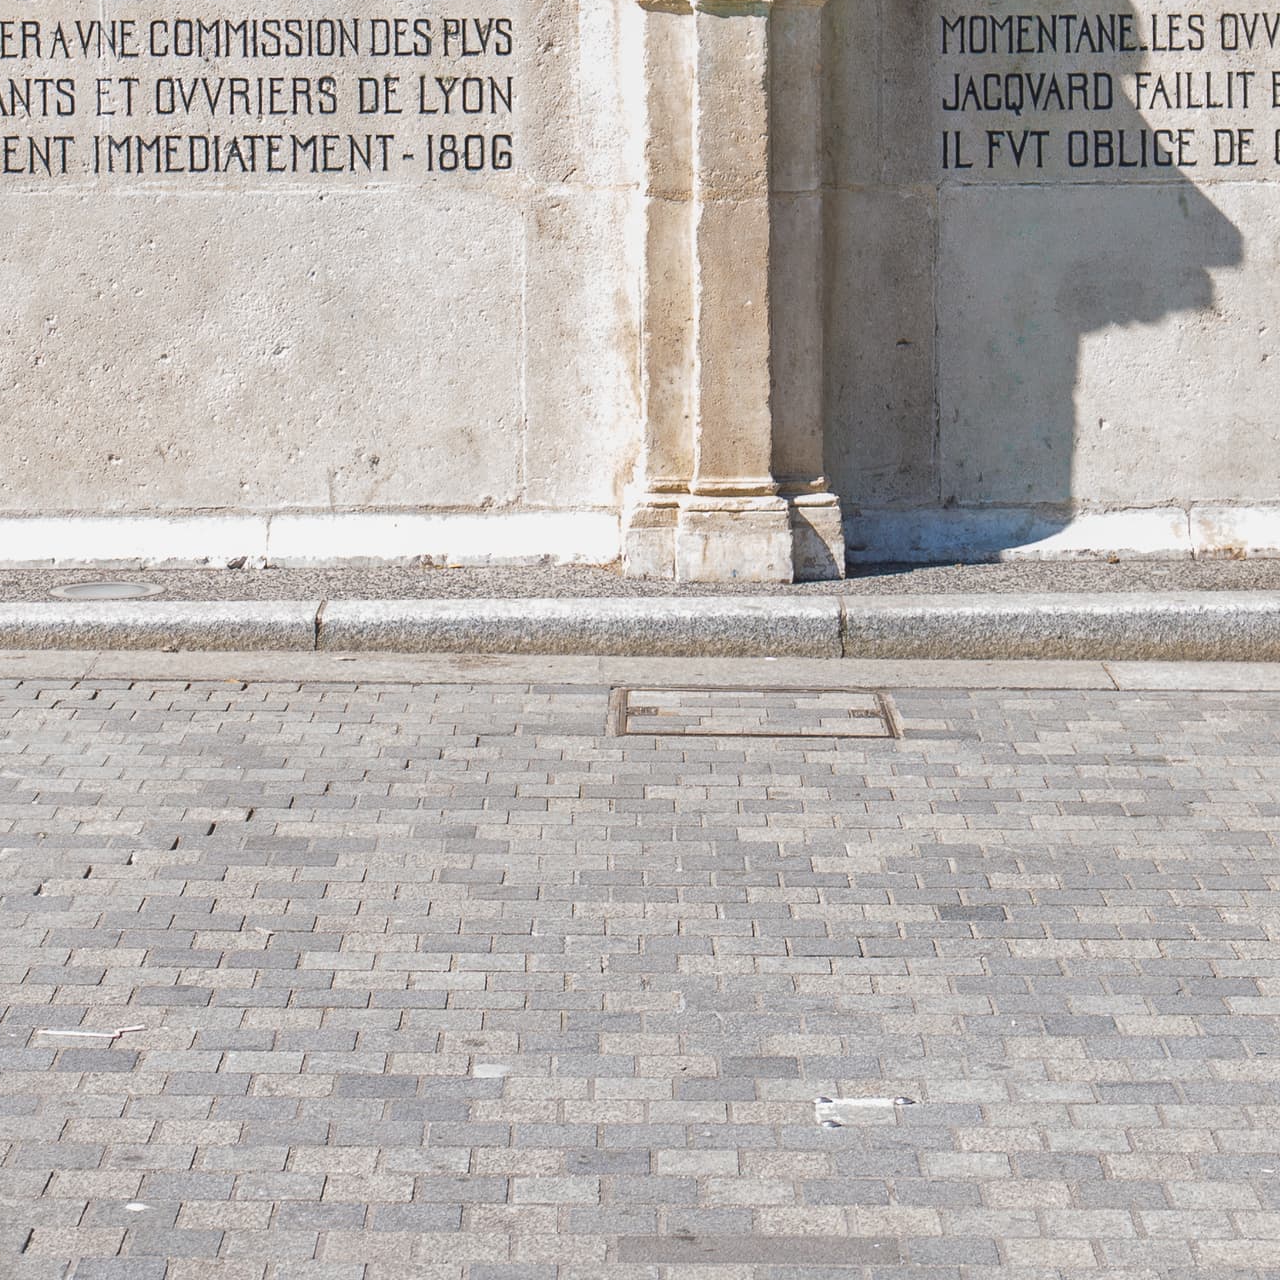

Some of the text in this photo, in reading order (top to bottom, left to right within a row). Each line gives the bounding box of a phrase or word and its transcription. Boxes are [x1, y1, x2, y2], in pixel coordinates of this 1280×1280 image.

[74, 19, 139, 59] VNE
[149, 17, 360, 58] COMMISSION
[369, 18, 432, 57] DES
[442, 17, 513, 57] PLVS
[95, 76, 140, 117] ET
[155, 75, 338, 116] OVVRIERS
[357, 76, 403, 115] DE
[418, 74, 513, 115] LYON
[942, 72, 1114, 116] JACQVARD
[1134, 70, 1256, 110] FAILLIT
[93, 134, 395, 174] IMMEDIATEMENT
[427, 134, 513, 172] 1806
[942, 130, 974, 170] IL
[985, 129, 1050, 169] FVT
[1067, 128, 1198, 169] OBLIGE
[1213, 128, 1258, 167] DE
